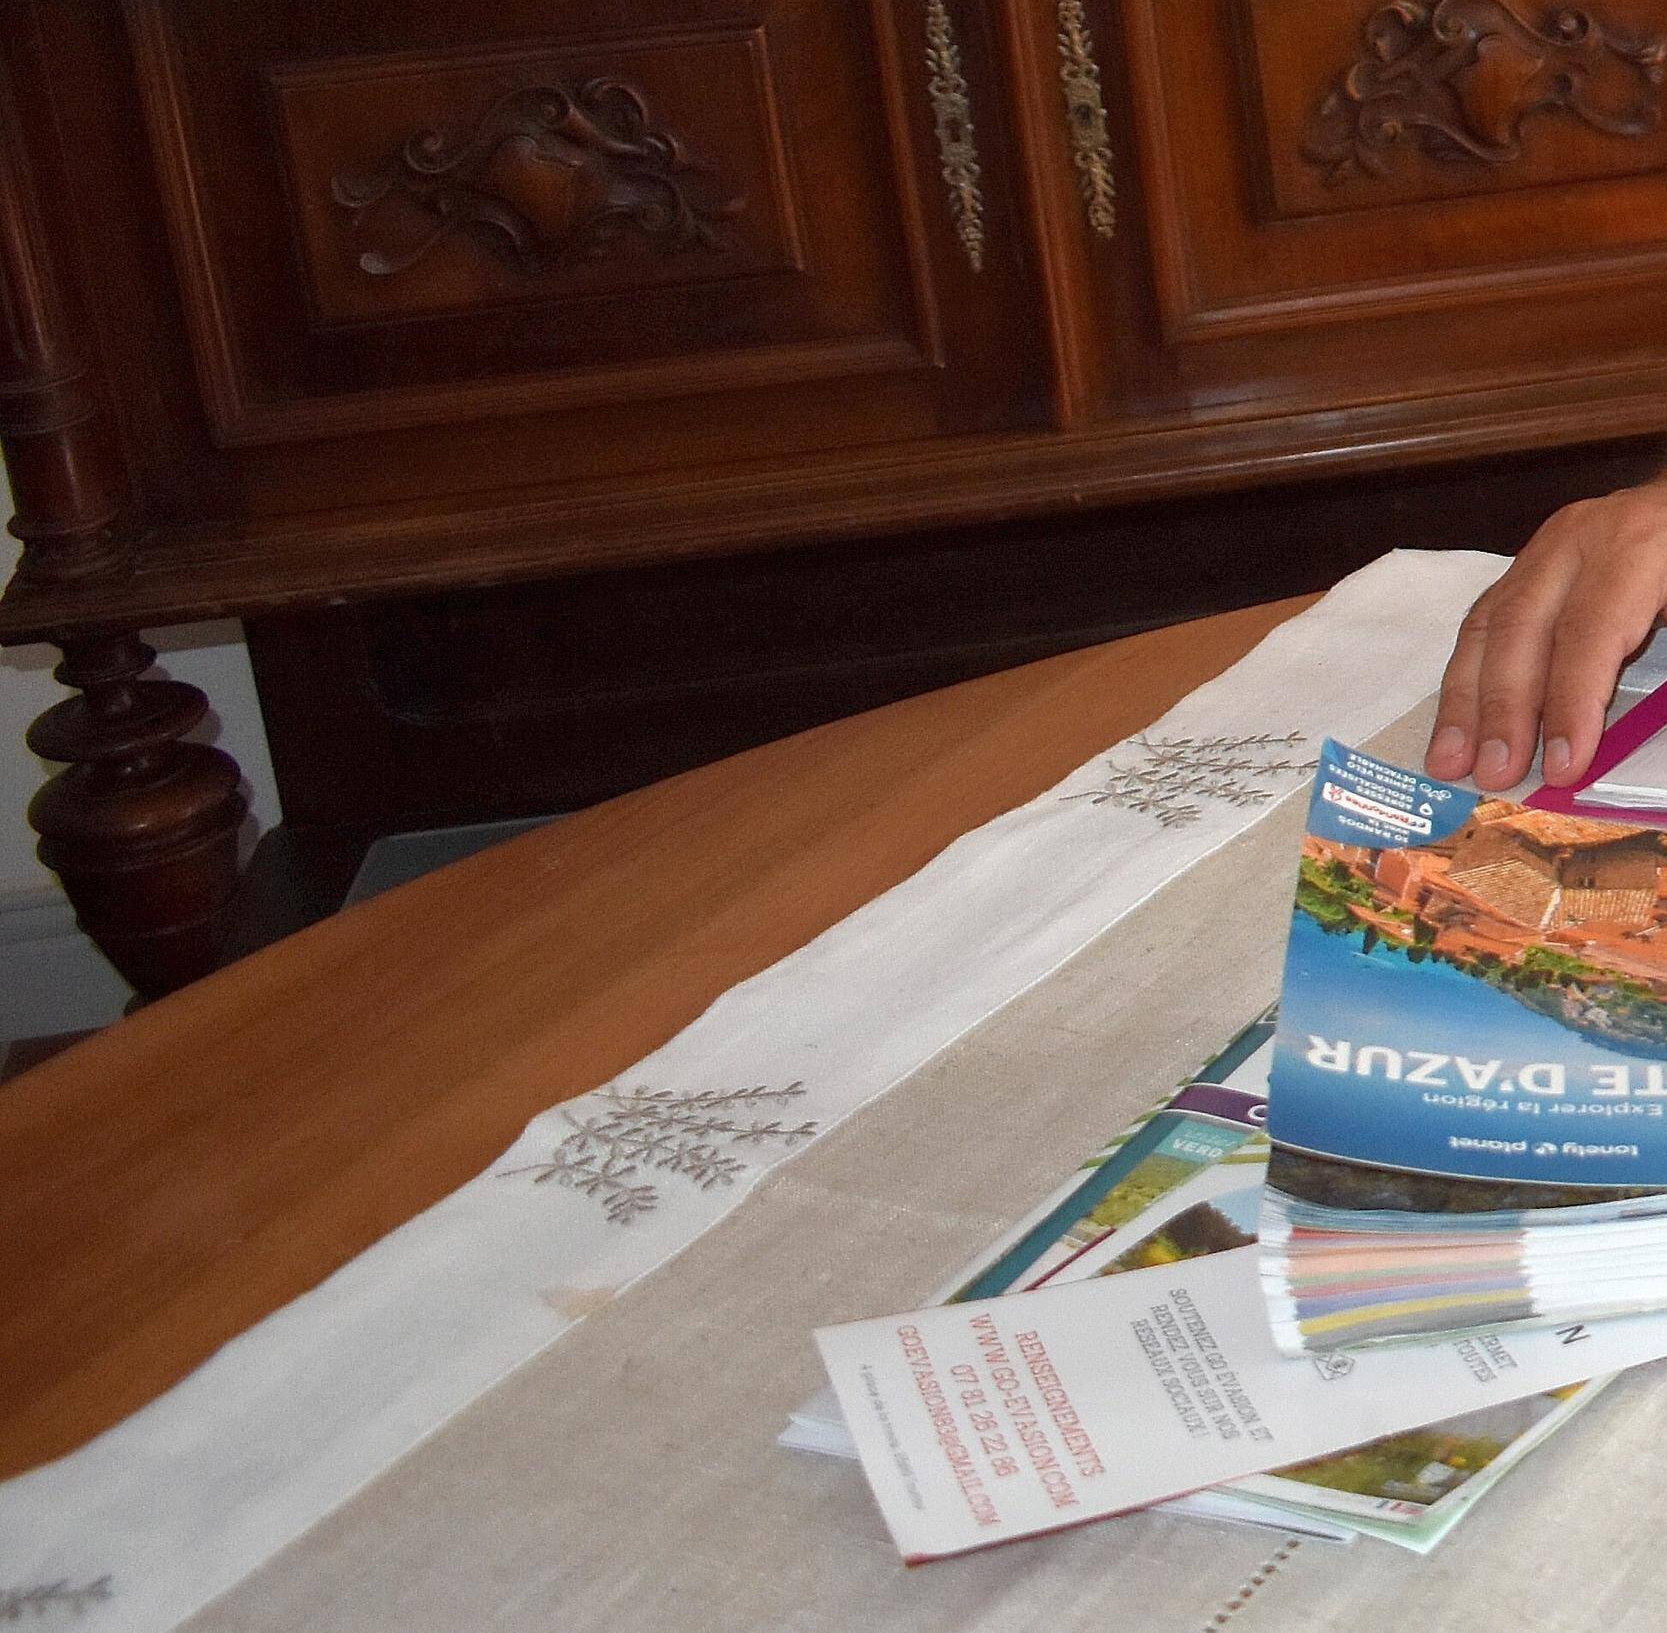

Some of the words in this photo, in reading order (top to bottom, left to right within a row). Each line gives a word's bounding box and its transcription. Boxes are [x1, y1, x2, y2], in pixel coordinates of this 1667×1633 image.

[1356, 785, 1412, 809] ADRESSES
[1338, 815, 1391, 837] RANDOS
[1305, 1034, 1567, 1095] D'AZUR
[1422, 1091, 1510, 1114] région
[1517, 1100, 1541, 1116] la
[1548, 1101, 1663, 1118] Explorer
[1448, 1135, 1528, 1154] planet
[1561, 1138, 1639, 1157] lonely
[1148, 1303, 1191, 1352] RENDEZ
[1168, 1287, 1219, 1352] SOUTENEZ
[1175, 1351, 1211, 1387] VOUS
[1012, 1329, 1107, 1477] RENSEIGNEMENTS
[1160, 1376, 1207, 1432] SOCIAUX
[1195, 1386, 1226, 1412] SUR
[1210, 1413, 1242, 1440] NOS
